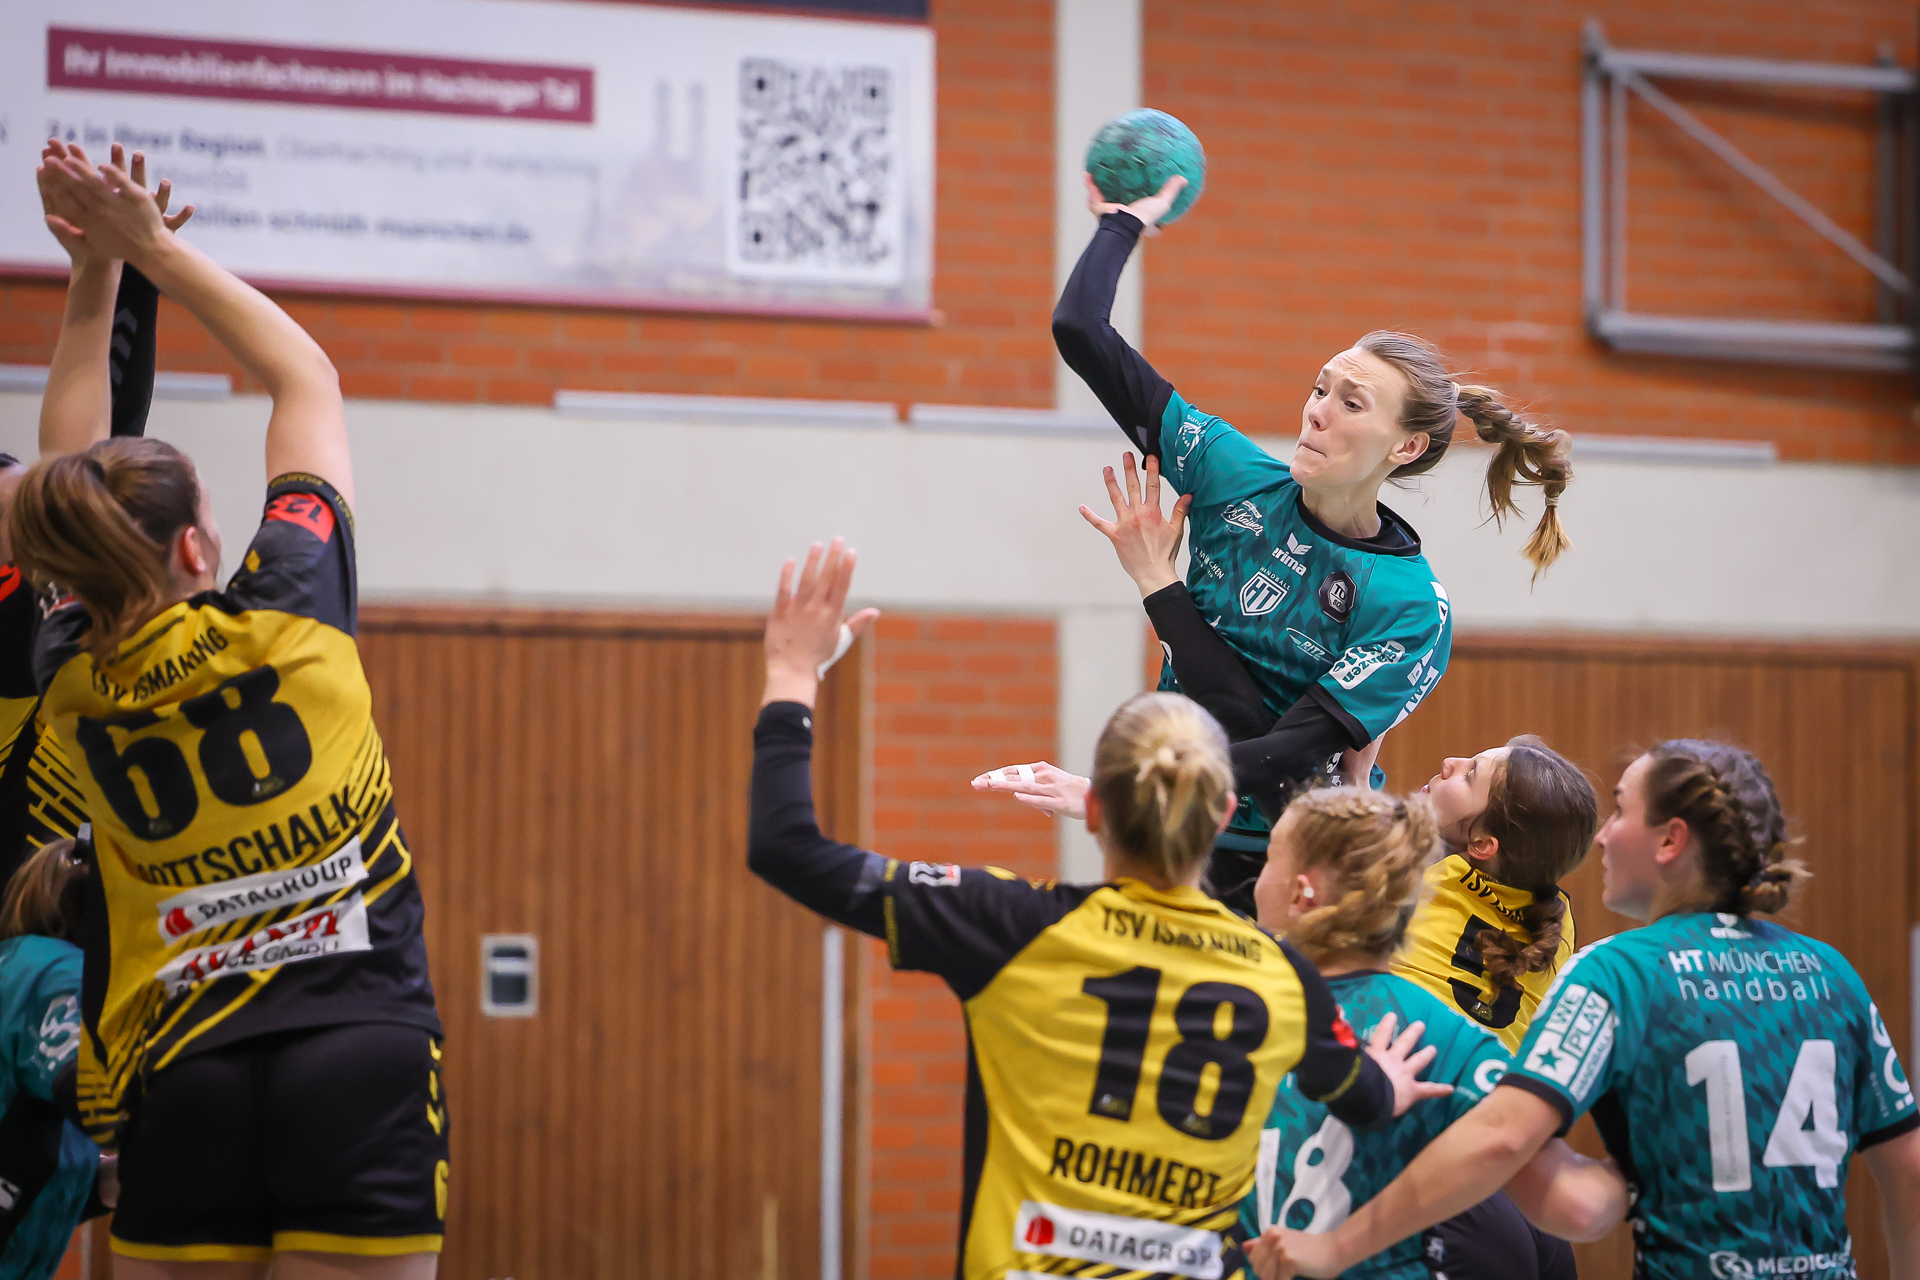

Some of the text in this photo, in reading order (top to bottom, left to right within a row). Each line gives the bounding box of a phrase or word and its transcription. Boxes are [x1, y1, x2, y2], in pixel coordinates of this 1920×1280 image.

[1272, 547, 1307, 576] erima
[1299, 640, 1326, 659] RITZ
[76, 664, 313, 843] 68
[137, 785, 361, 887] OTTSCHALK
[198, 856, 352, 920] DATAGROUP
[1104, 907, 1146, 939] TSV
[1667, 947, 1823, 974] HT MÜNCHEN
[1676, 975, 1832, 1002] handball
[1081, 965, 1270, 1142] 18
[1568, 997, 1606, 1052] PLAY
[1684, 1039, 1848, 1192] 14
[1050, 1137, 1221, 1209] ROHMERT
[1254, 1114, 1354, 1235] 18
